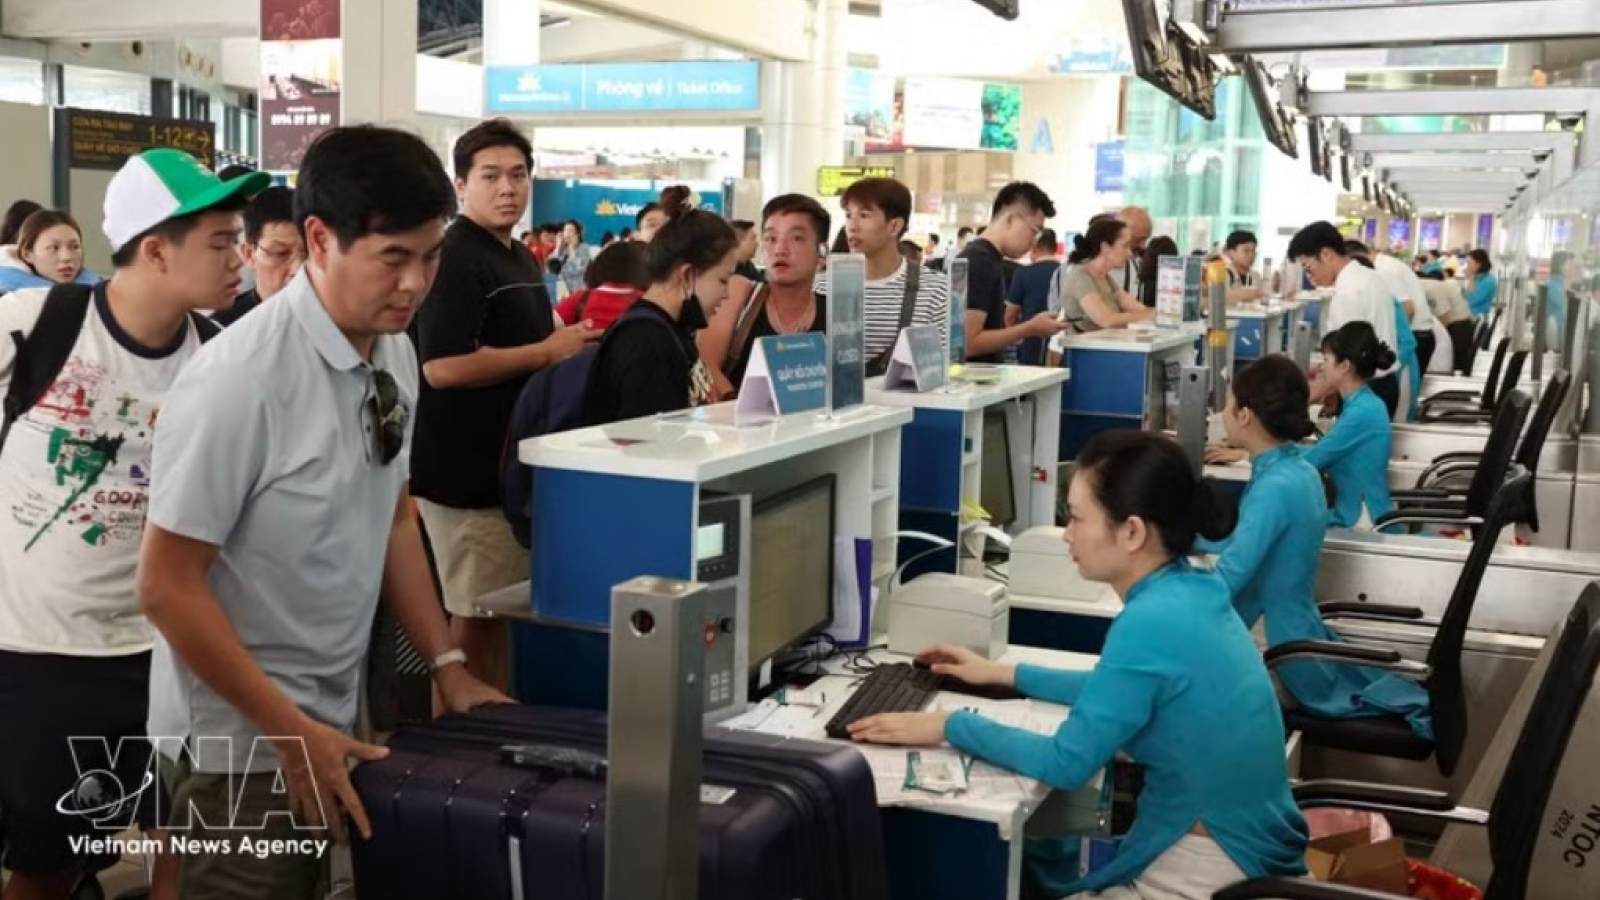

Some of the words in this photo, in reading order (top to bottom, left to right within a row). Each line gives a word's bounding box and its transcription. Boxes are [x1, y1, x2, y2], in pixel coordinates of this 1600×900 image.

[709, 80, 744, 94] Office
[149, 124, 182, 146] 1-12
[1030, 118, 1053, 153] A
